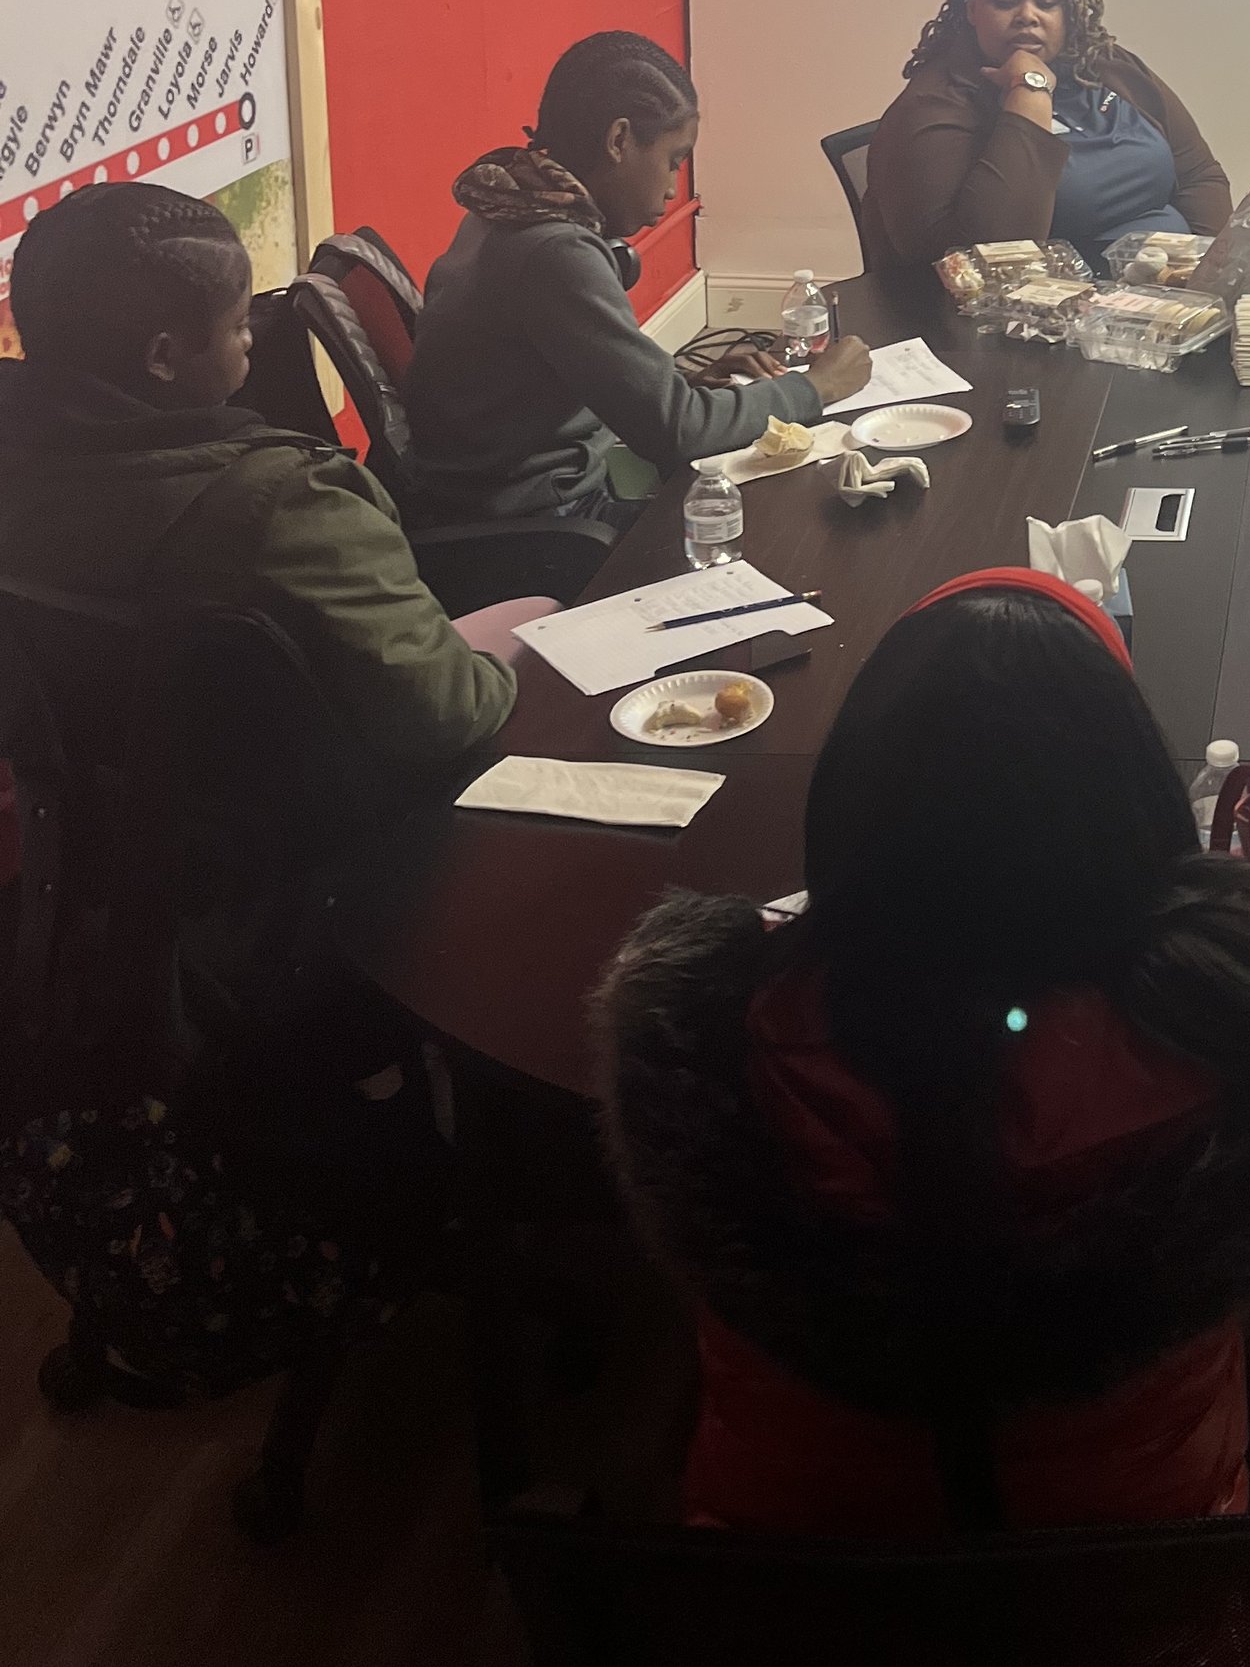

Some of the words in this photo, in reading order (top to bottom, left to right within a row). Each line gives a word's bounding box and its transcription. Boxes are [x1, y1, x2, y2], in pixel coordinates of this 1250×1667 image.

[92, 26, 146, 147] Thorndale
[128, 28, 173, 133] Granville
[158, 41, 193, 121] Loyola
[186, 36, 218, 110] Morse
[217, 29, 243, 98] Jarvis
[240, 0, 274, 86] Howard
[24, 79, 71, 177] Berwyn
[59, 100, 91, 163] Bryn
[85, 27, 117, 98] Mawr
